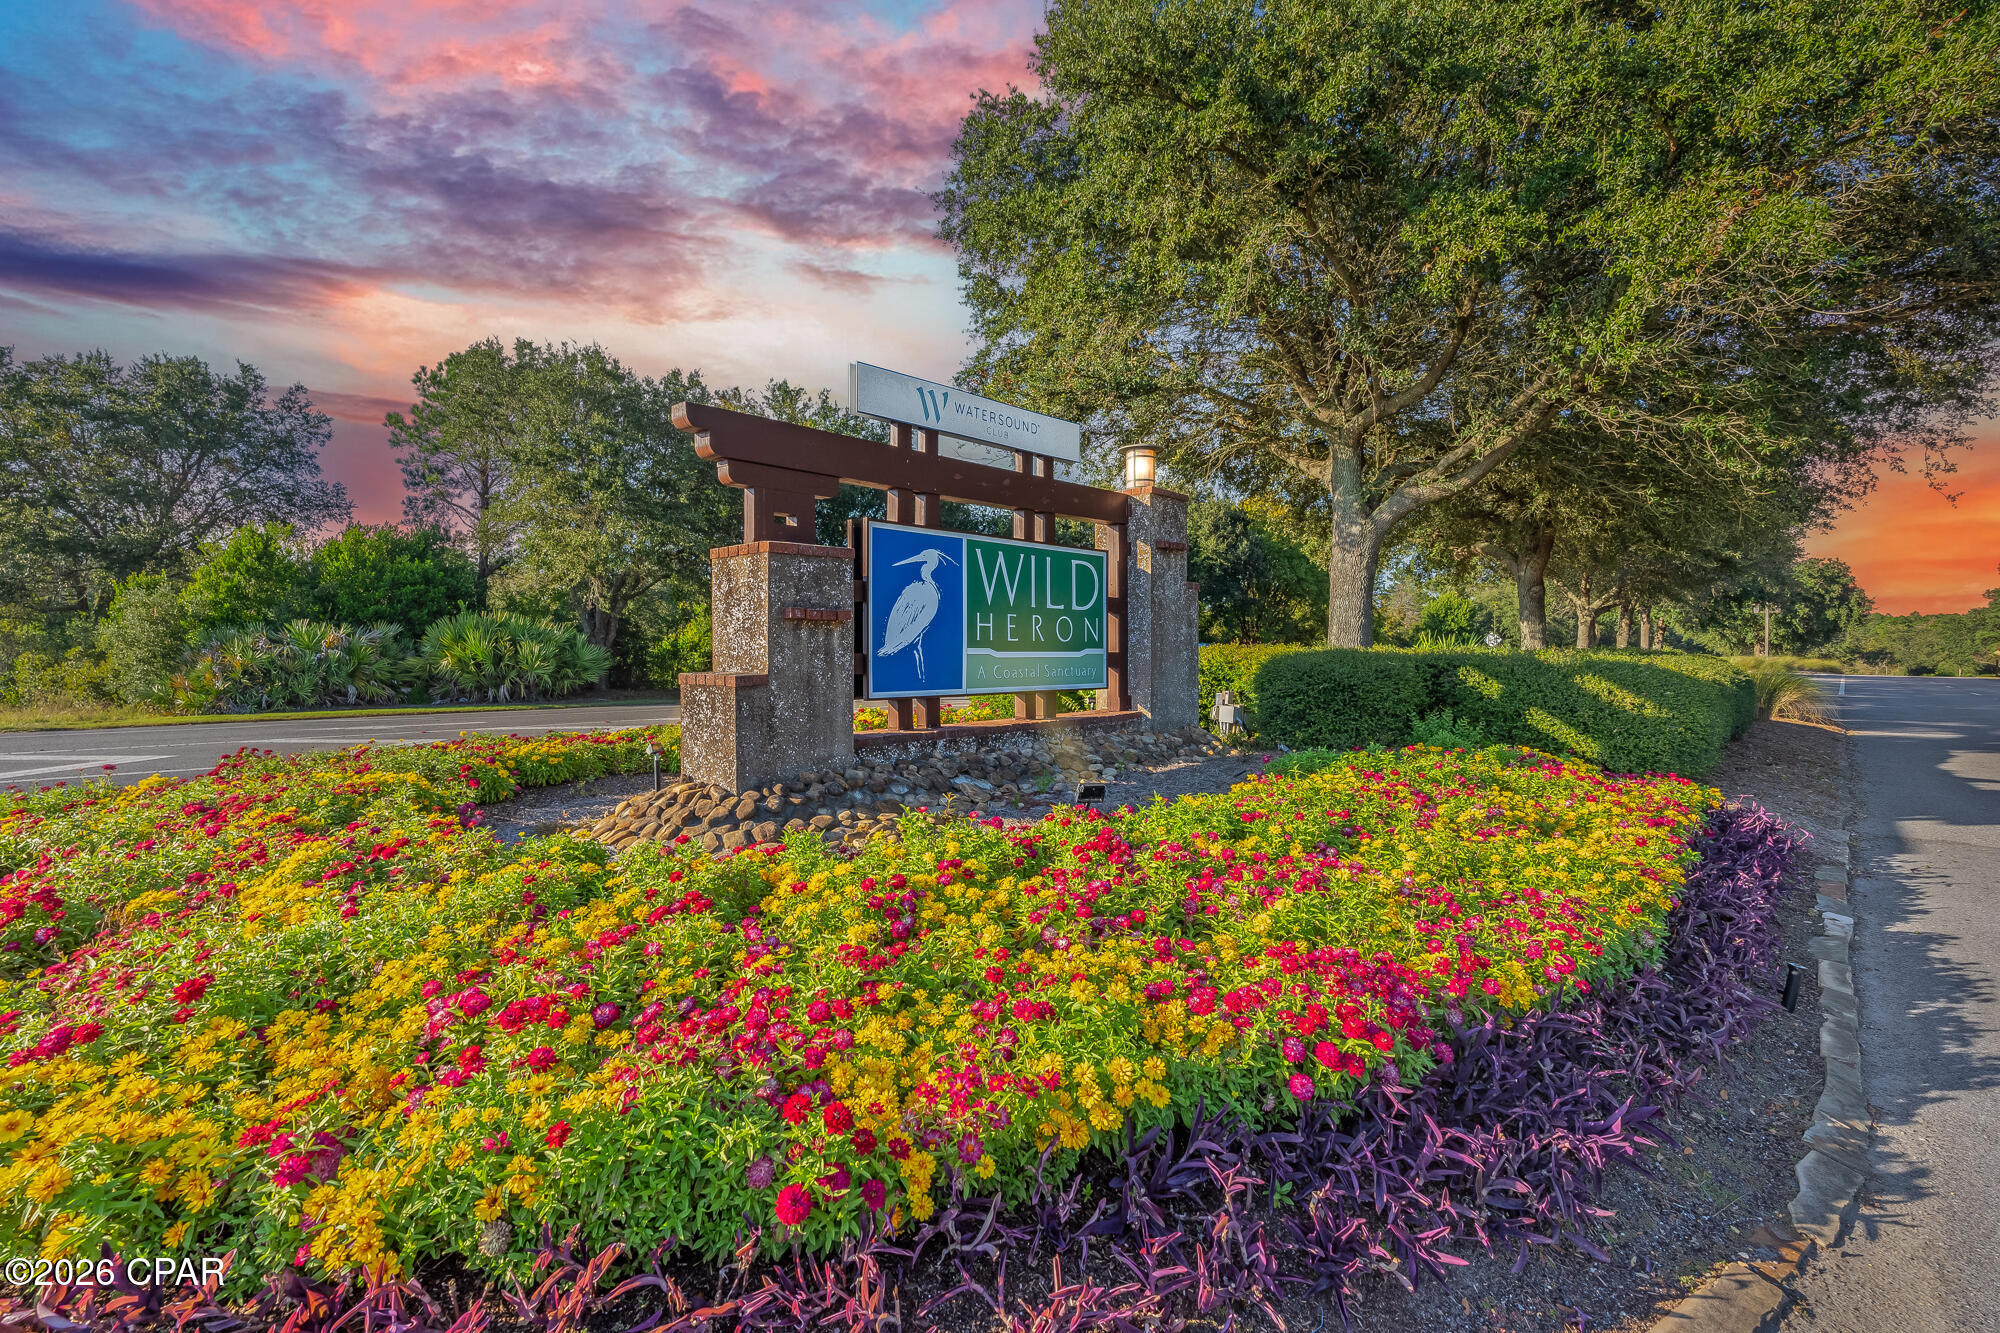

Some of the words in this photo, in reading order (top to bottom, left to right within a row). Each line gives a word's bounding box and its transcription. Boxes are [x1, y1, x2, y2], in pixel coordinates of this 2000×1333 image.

[954, 401, 1038, 435] WATERSOUND
[986, 426, 1009, 440] CLUB
[975, 548, 1099, 611] WILD
[976, 612, 1099, 643] HERON
[977, 665, 986, 680] A
[993, 663, 1040, 679] Coastal
[1044, 662, 1097, 680] Sanctuary
